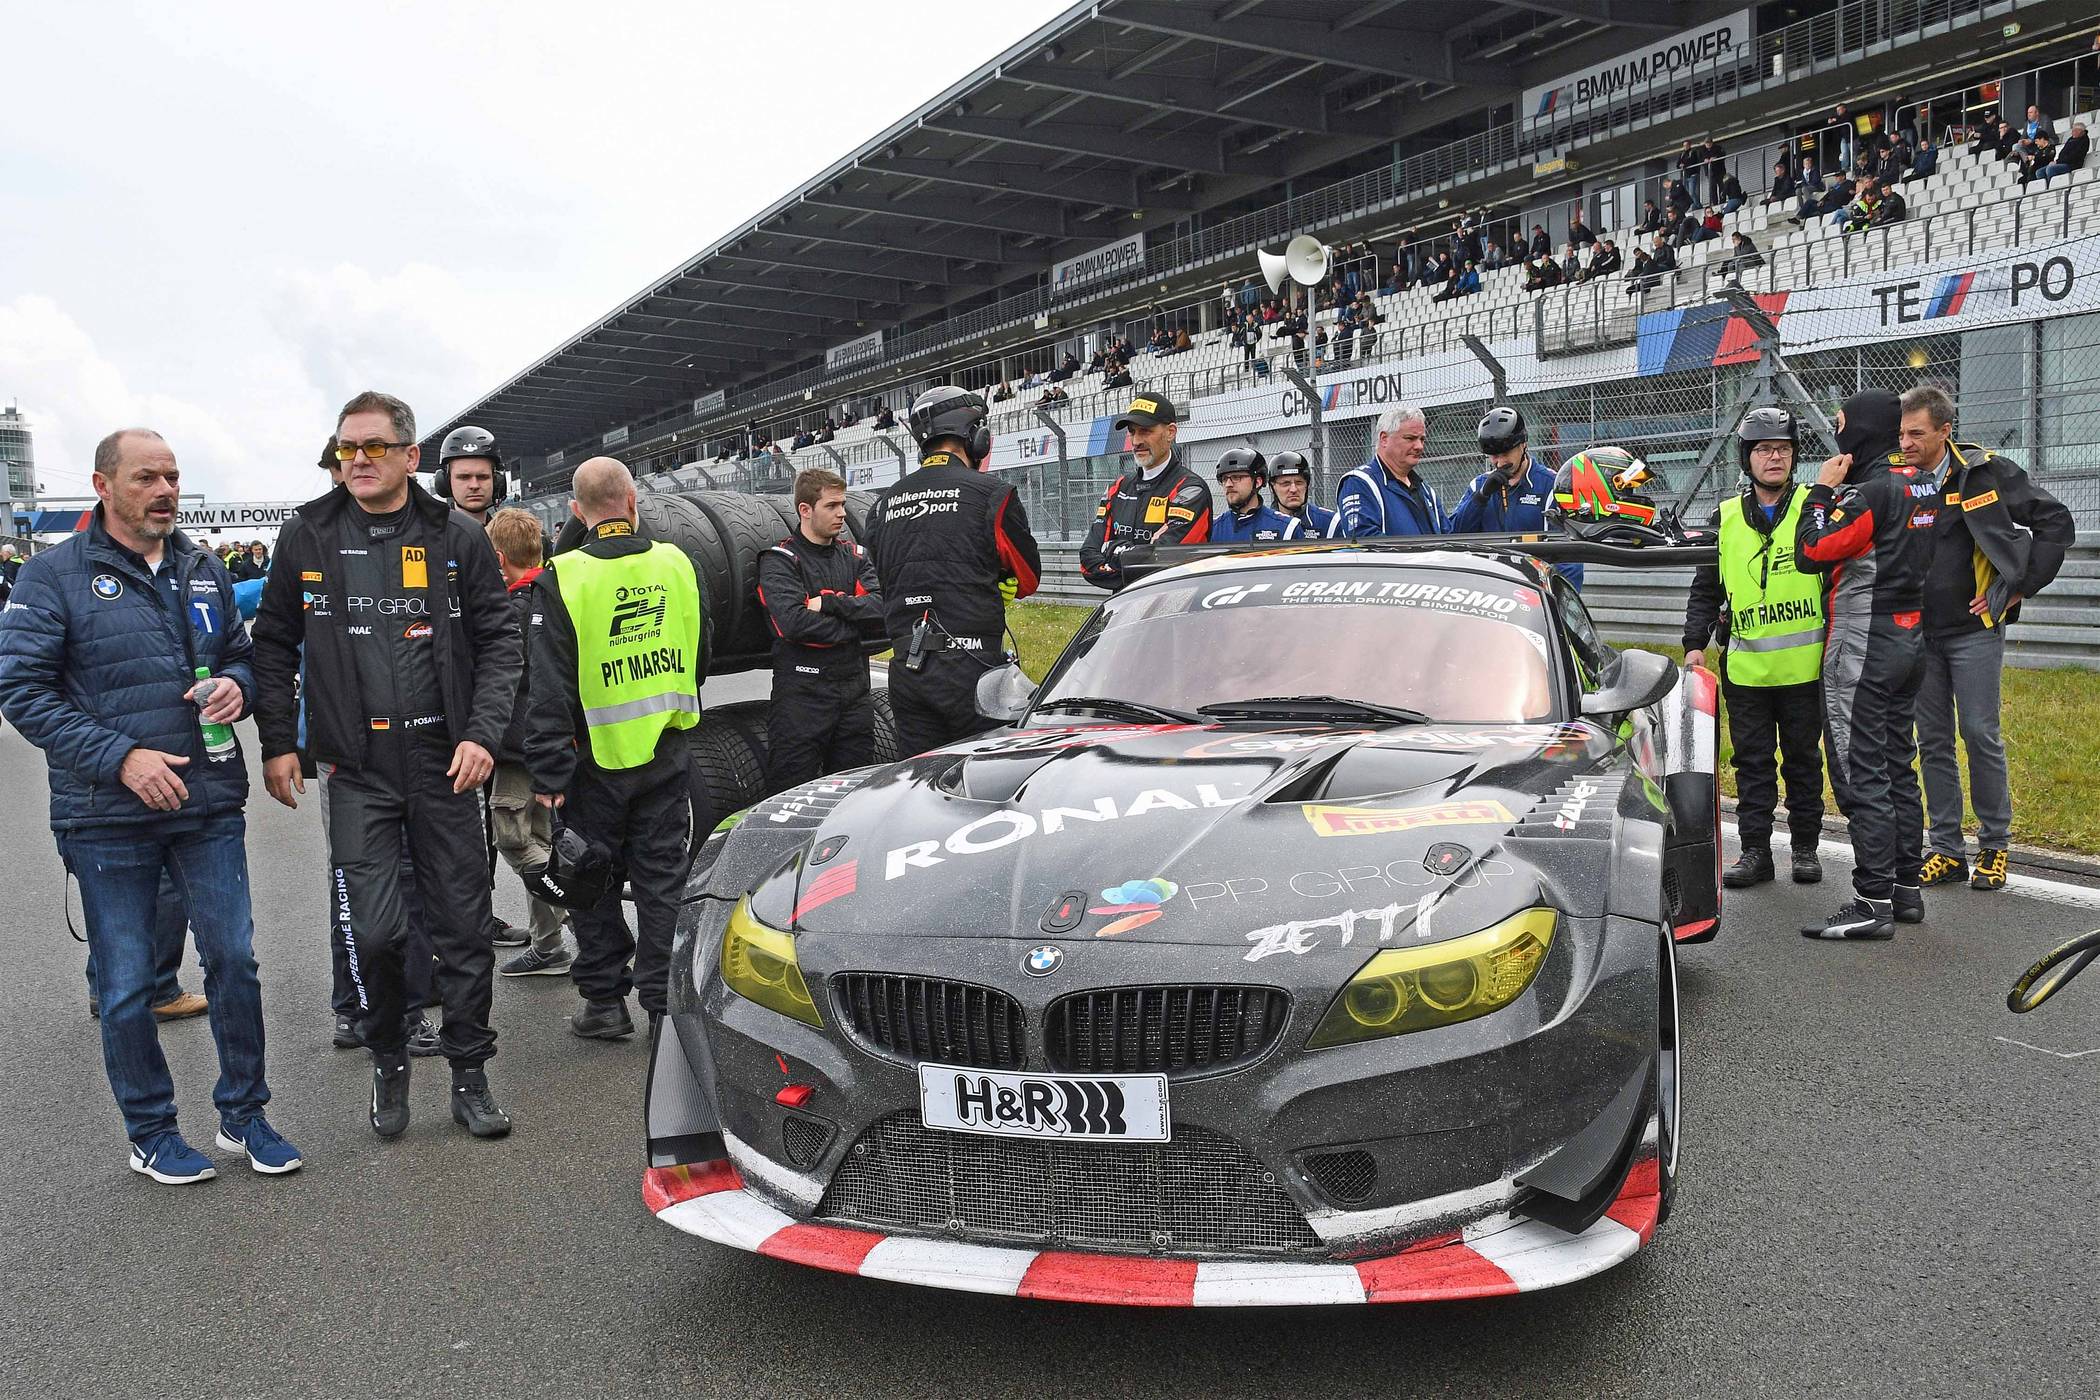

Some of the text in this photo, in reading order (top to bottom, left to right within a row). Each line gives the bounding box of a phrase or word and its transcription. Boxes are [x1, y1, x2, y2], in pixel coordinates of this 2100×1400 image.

[1576, 27, 1732, 104] BMW M POWER
[1075, 256, 1095, 276] BMW
[1105, 241, 1137, 267] POWER
[1871, 255, 2074, 327] TE PO
[885, 500, 958, 523] MotorSport
[887, 488, 960, 507] Walkenhorst
[1964, 493, 1994, 509] PIRELLI
[221, 510, 235, 523] M
[348, 597, 373, 612] PP
[630, 584, 668, 595] TOTAL
[1282, 581, 1373, 597] GRAN
[1377, 582, 1518, 613] TURISMO
[193, 602, 213, 633] T
[1355, 597, 1417, 606] DRIVING
[1420, 600, 1508, 621] SIMULATOR
[1738, 597, 1817, 631] PIT MARSHAL
[348, 626, 372, 635] NAL
[609, 627, 662, 648] nürburgring
[601, 658, 624, 688] PIT
[884, 783, 1252, 881] RONAL
[1323, 805, 1496, 833] PIRELLI
[335, 868, 351, 921] RACING
[541, 874, 565, 897] uvex
[1184, 857, 1514, 911] PP GROUP
[341, 923, 362, 984] SPEEDLINE
[955, 1075, 1062, 1130] H&R
